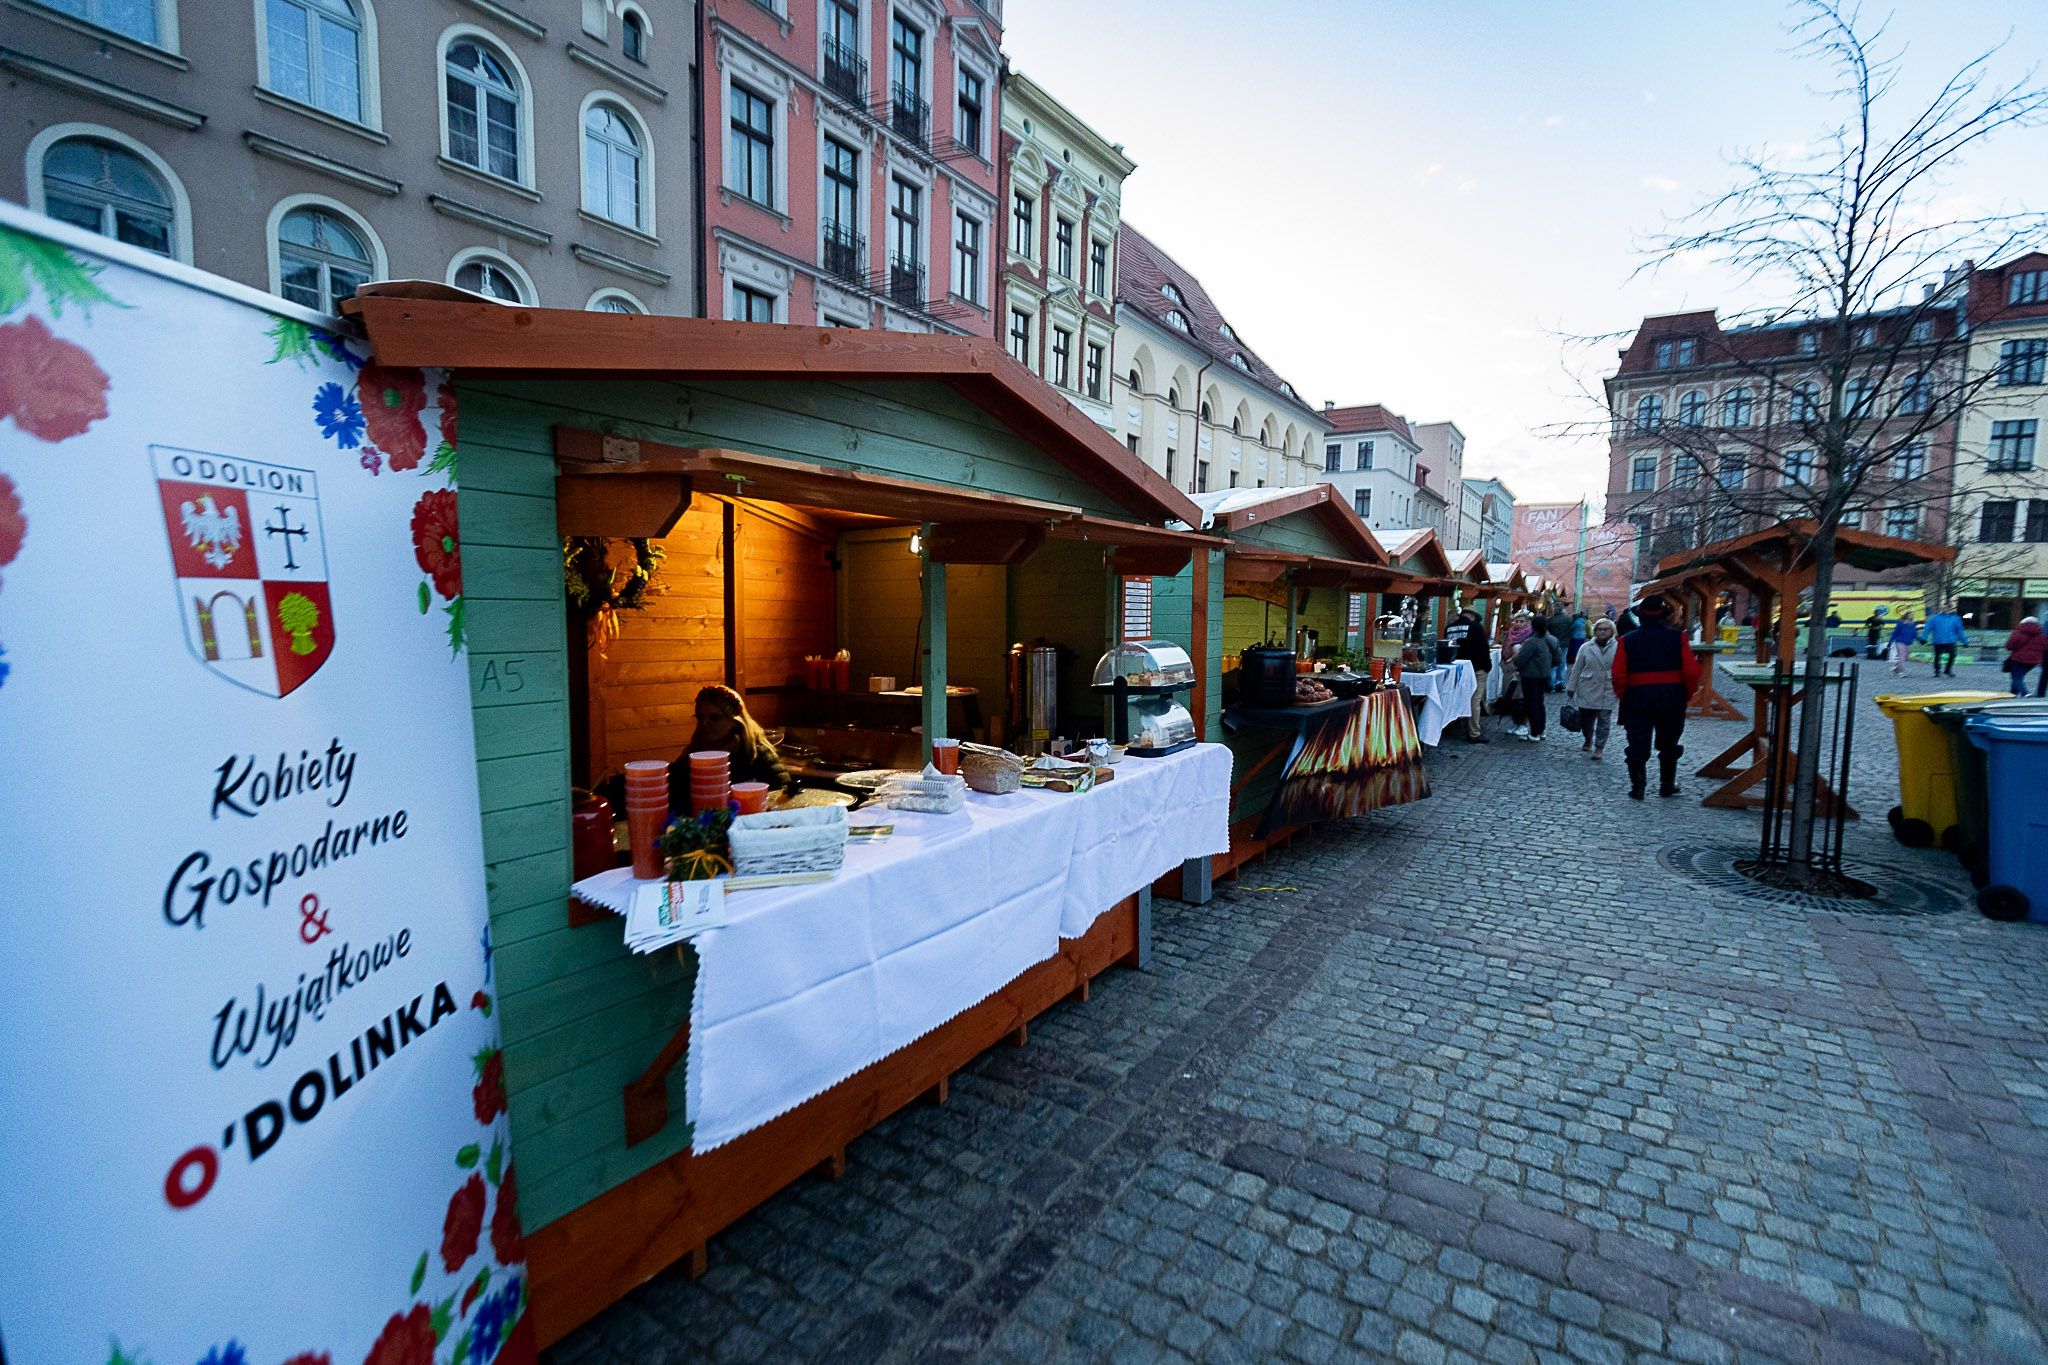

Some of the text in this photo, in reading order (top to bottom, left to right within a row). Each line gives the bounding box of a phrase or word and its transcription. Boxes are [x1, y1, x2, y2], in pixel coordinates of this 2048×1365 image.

[171, 454, 304, 494] ODOLION
[1528, 509, 1558, 523] FAN
[1535, 522, 1566, 533] SPOT
[1592, 531, 1616, 541] FAN
[480, 658, 525, 693] A5
[209, 736, 359, 820] Kobiety
[162, 806, 410, 930] Gospodarne
[298, 892, 333, 945] &
[209, 926, 413, 1072] Wyjątkowe
[163, 980, 458, 1211] O'DOLINKA
